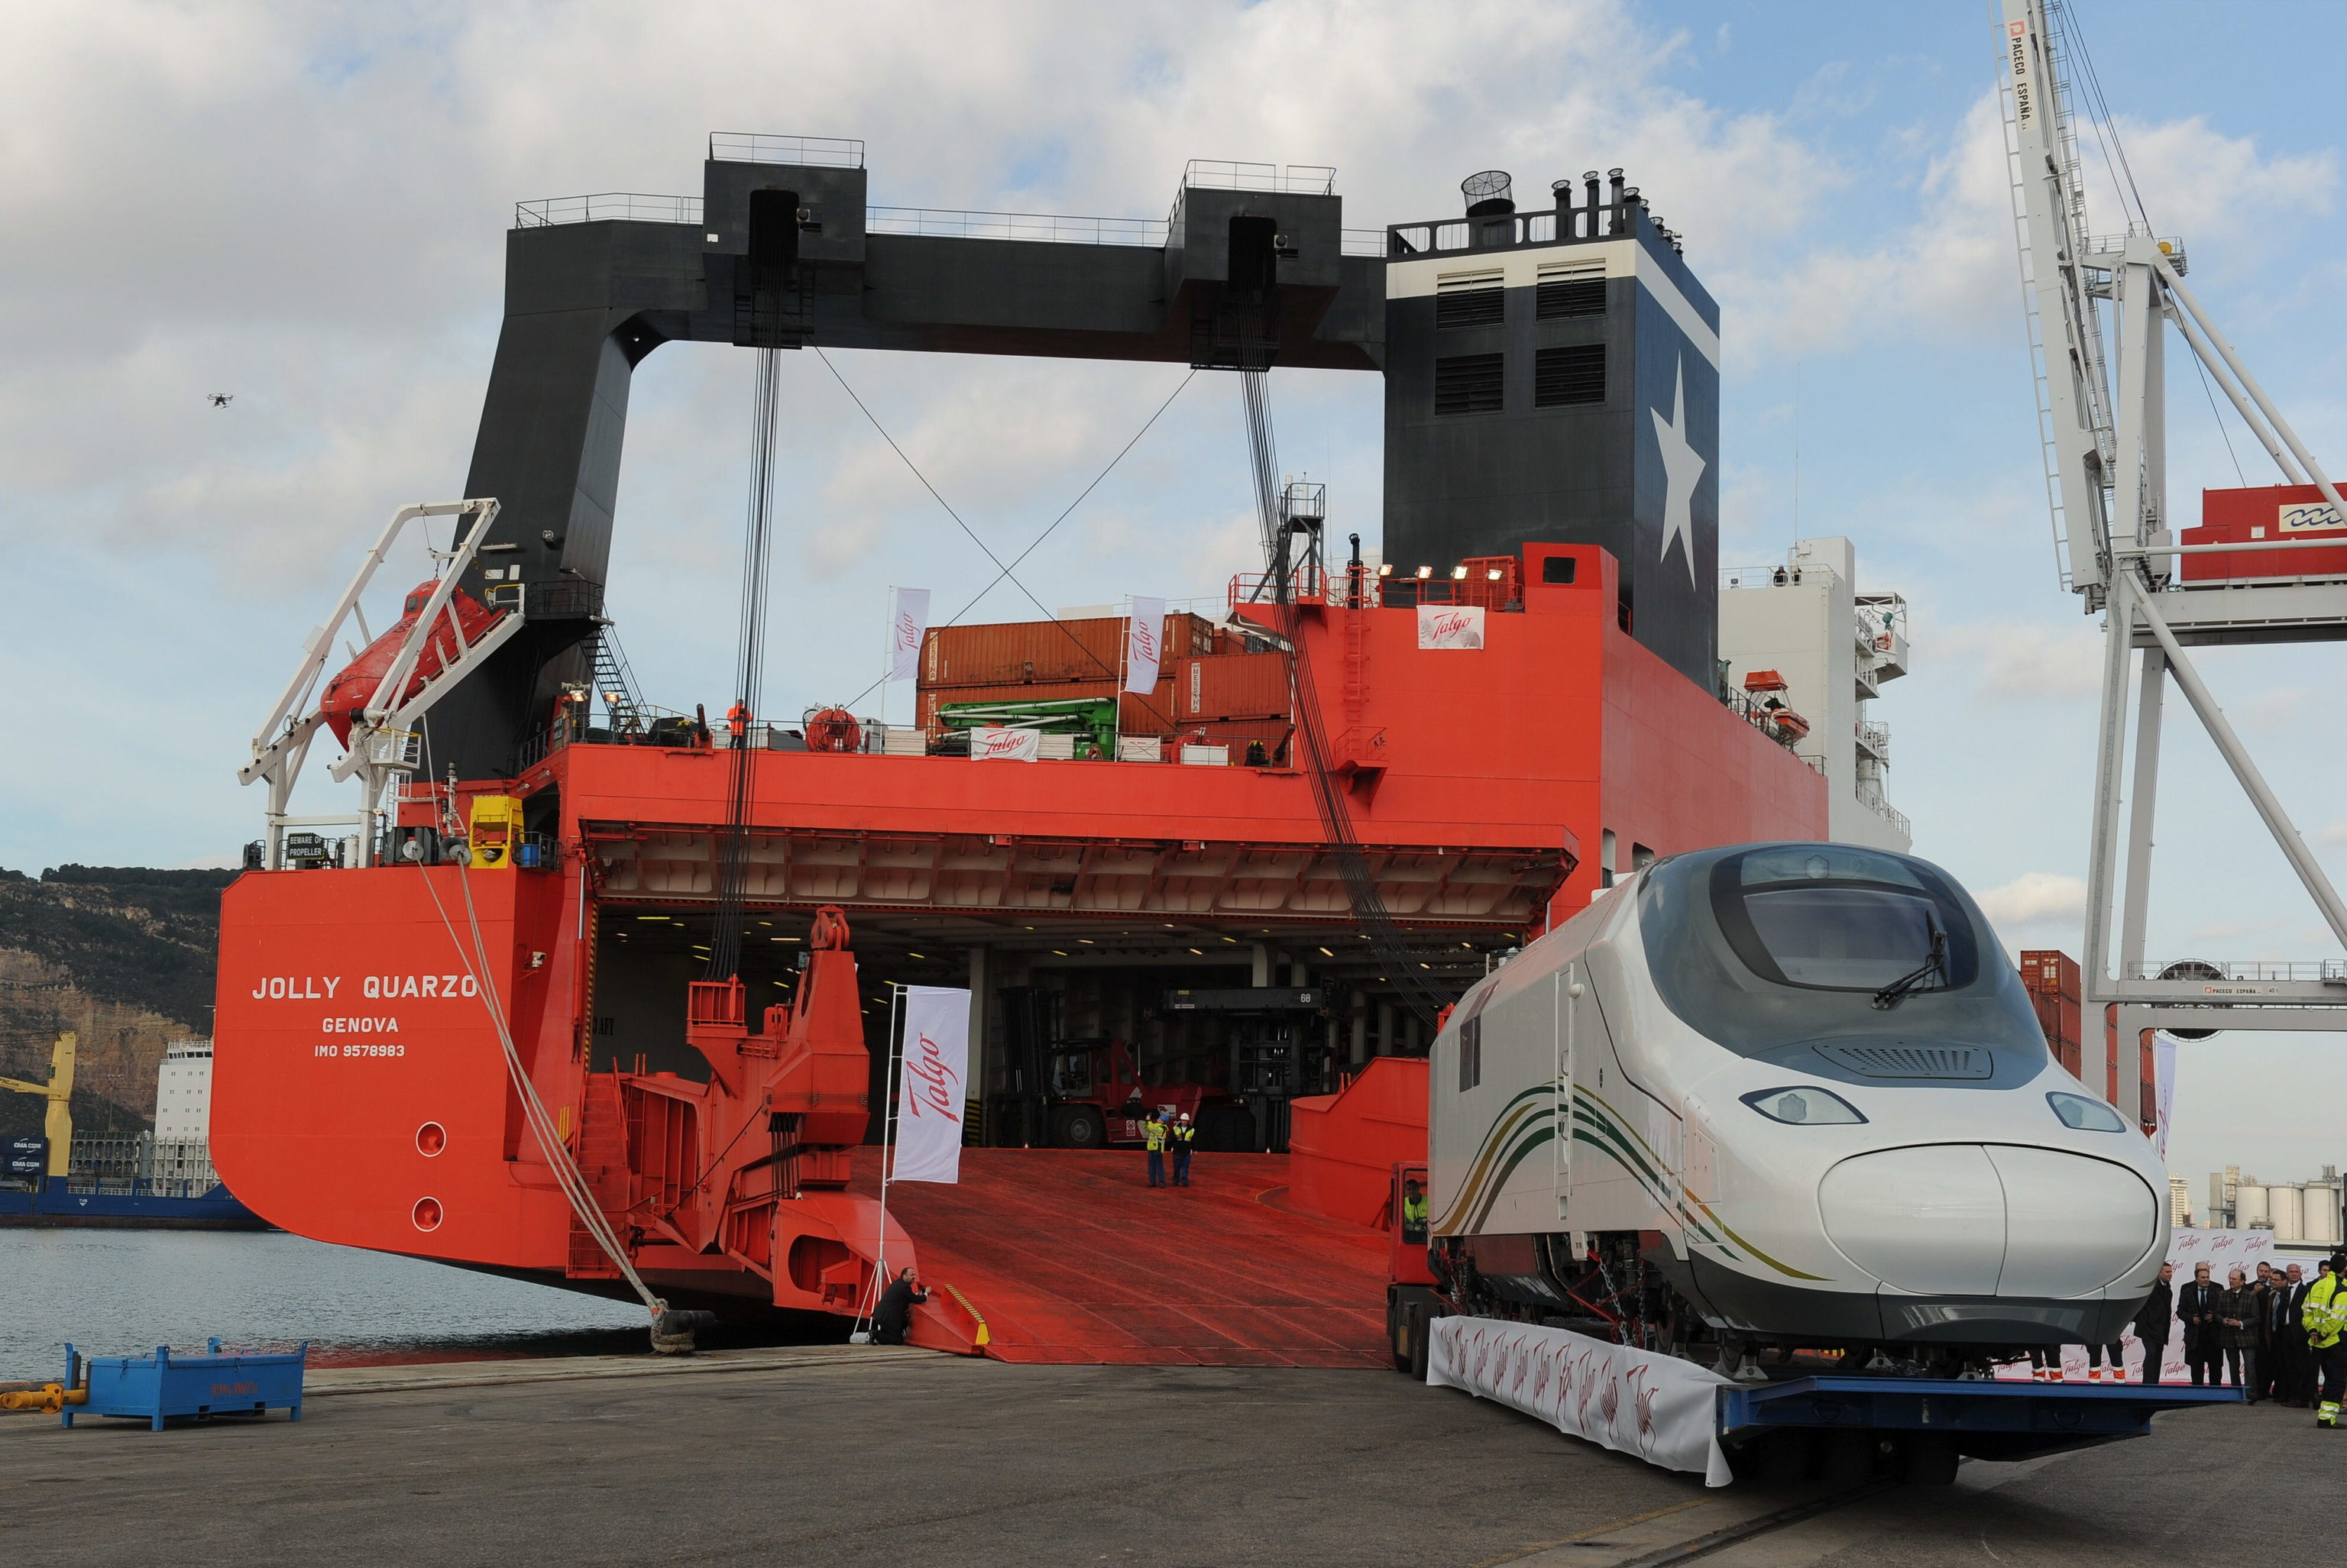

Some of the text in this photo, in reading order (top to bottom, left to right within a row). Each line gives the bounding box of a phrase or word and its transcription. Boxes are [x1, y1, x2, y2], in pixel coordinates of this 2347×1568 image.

[2012, 37, 2025, 76] PACECO
[2017, 82, 2032, 121] ESPAÑA
[896, 611, 921, 651] Talgo
[1432, 612, 1473, 641] Talgo
[1131, 619, 1159, 665] Talgo
[985, 730, 1028, 755] Talgo
[290, 836, 322, 844] BEWARE OF
[290, 848, 322, 856] PROPELLER
[252, 975, 478, 999] JOLLY QUARZO
[1300, 994, 1311, 1003] 68
[322, 1017, 399, 1033] GENOVA
[314, 1045, 405, 1057] IMO 9578983
[906, 1032, 960, 1123] Talgo
[2178, 1235, 2200, 1251] Talgo
[2211, 1235, 2234, 1252] Talgo
[2244, 1237, 2268, 1253] Talgo
[2064, 1359, 2086, 1375] Talgo
[2164, 1361, 2186, 1377] Talgo
